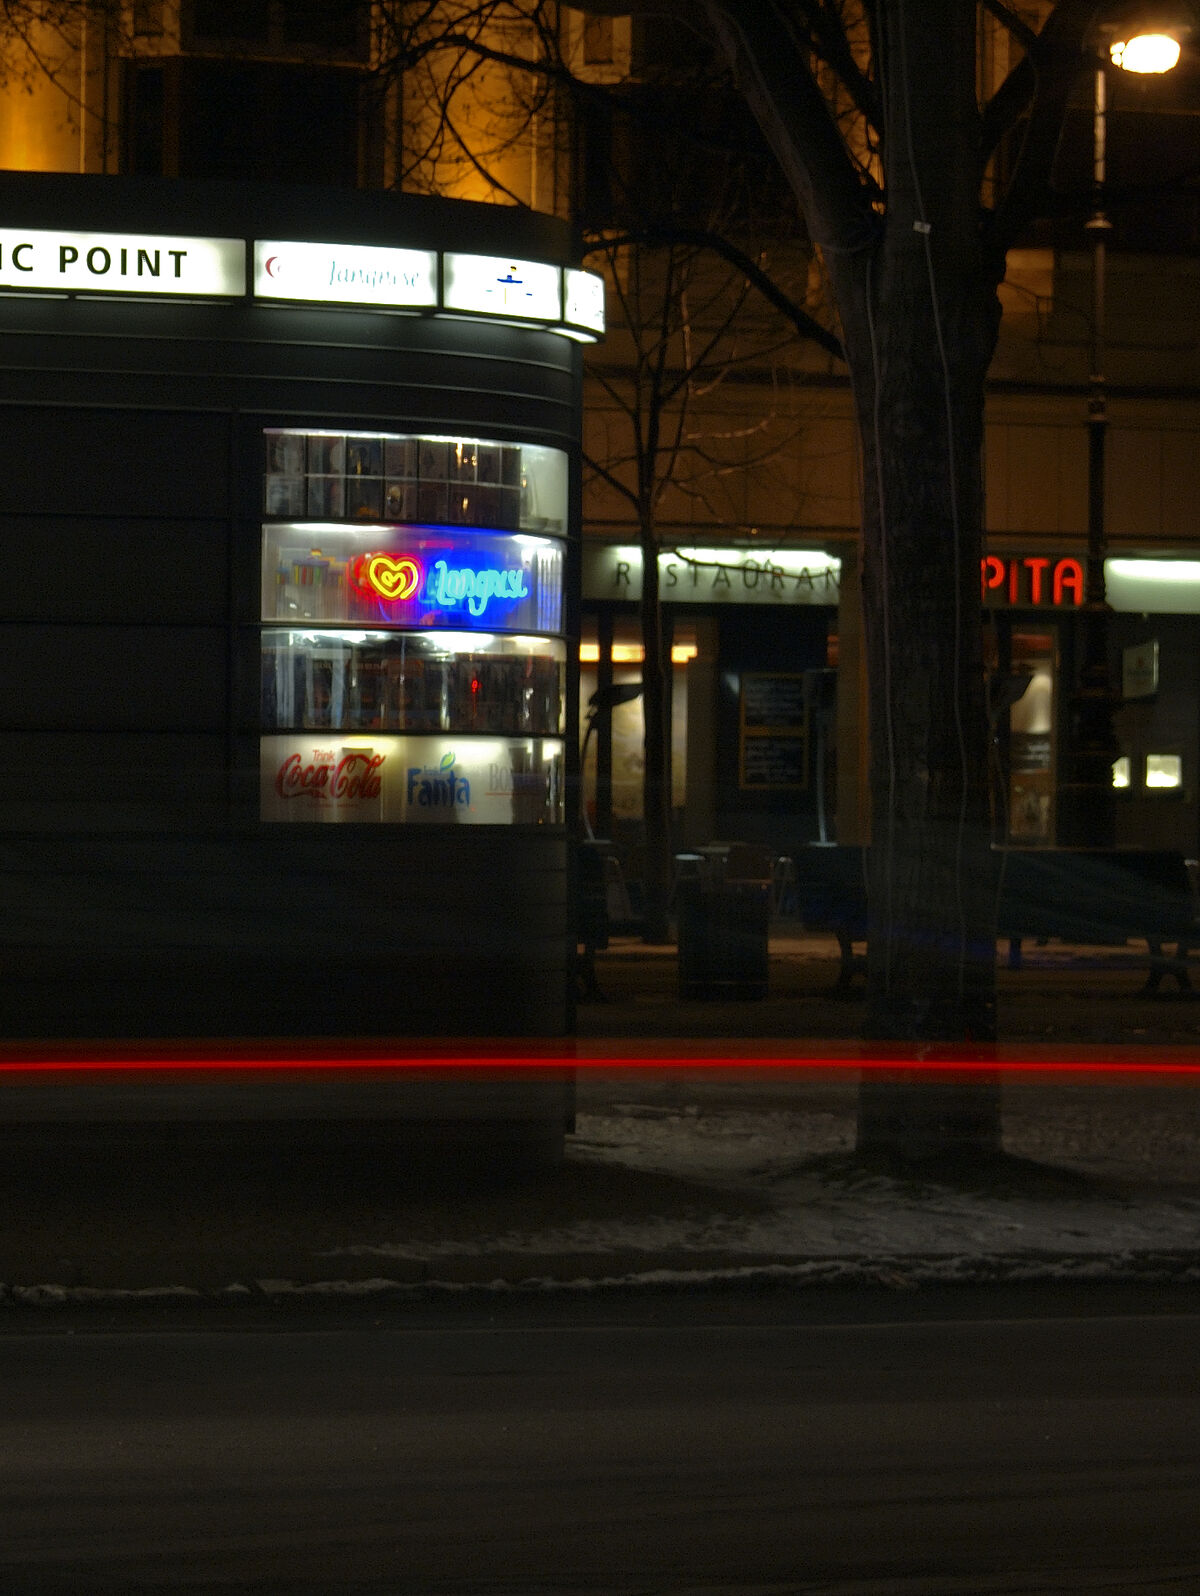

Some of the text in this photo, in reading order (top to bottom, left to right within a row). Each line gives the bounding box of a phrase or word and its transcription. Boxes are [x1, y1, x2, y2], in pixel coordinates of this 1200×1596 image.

[58, 245, 189, 278] POINT
[616, 559, 842, 590] RSTAURAN
[980, 555, 1085, 606] PITA
[407, 767, 471, 809] Fanta
